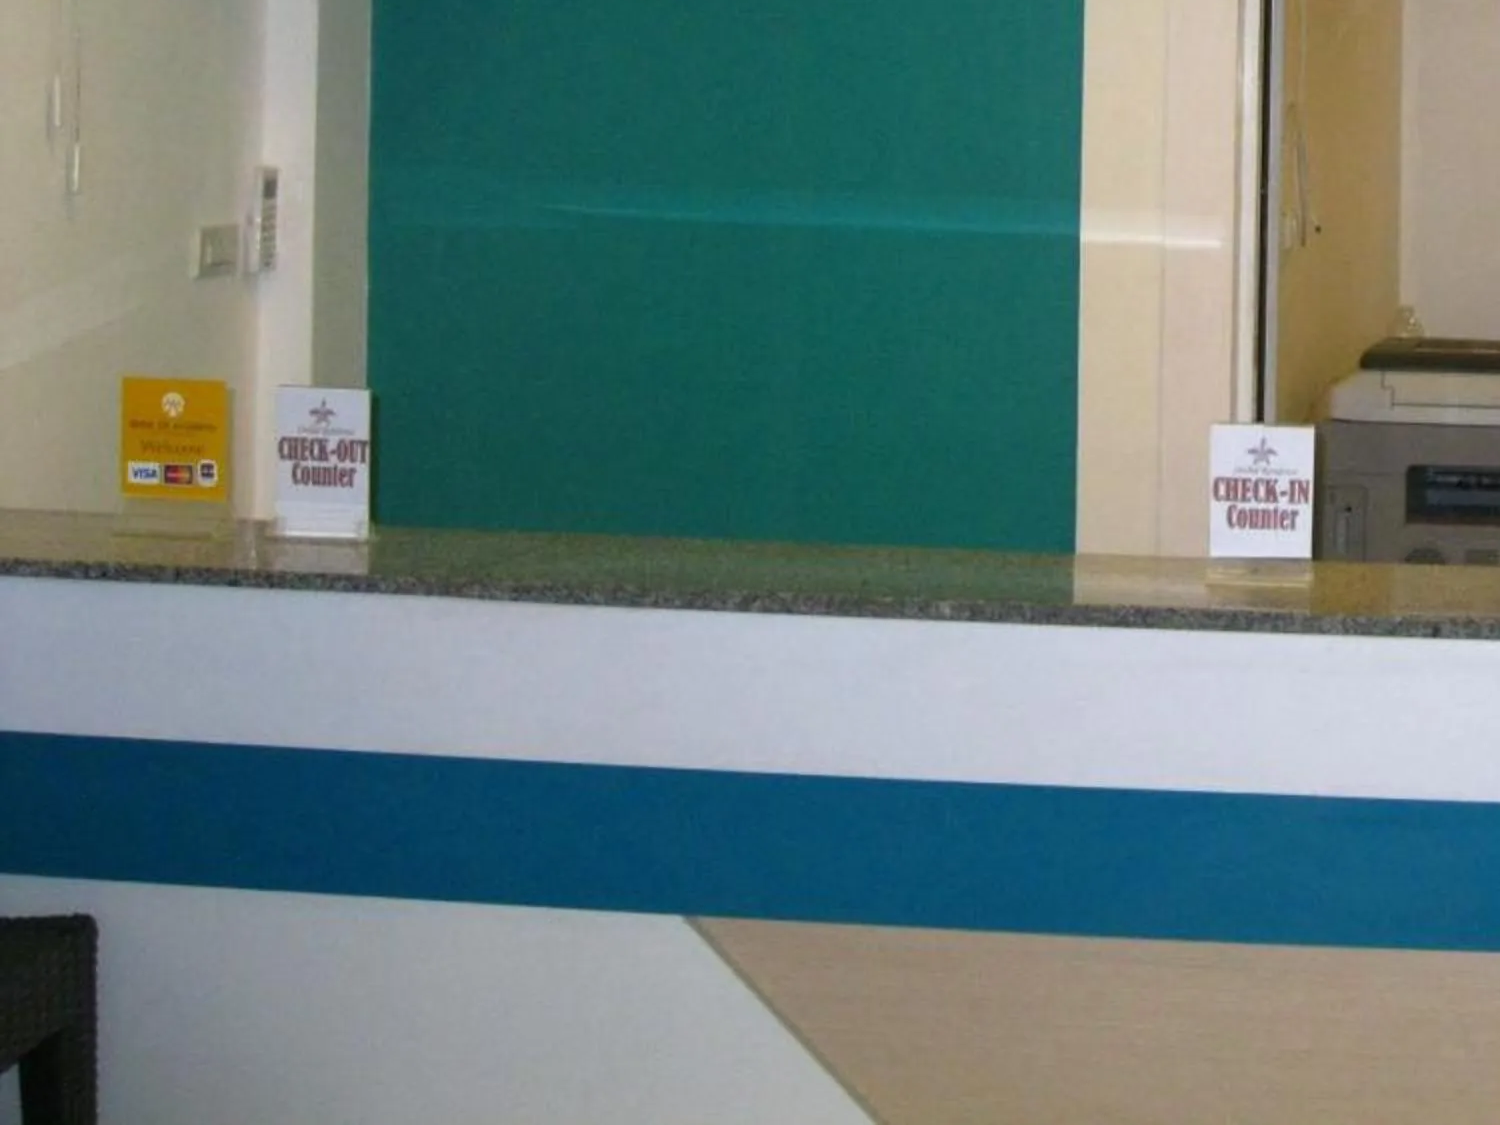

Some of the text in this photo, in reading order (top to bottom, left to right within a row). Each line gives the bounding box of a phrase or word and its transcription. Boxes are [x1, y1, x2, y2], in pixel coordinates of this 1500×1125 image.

[278, 437, 369, 463] CHECK-OUT
[131, 466, 159, 479] VISA
[291, 461, 357, 489] Counter
[1212, 477, 1310, 505] CHECK-IN
[1226, 504, 1299, 531] Counter
